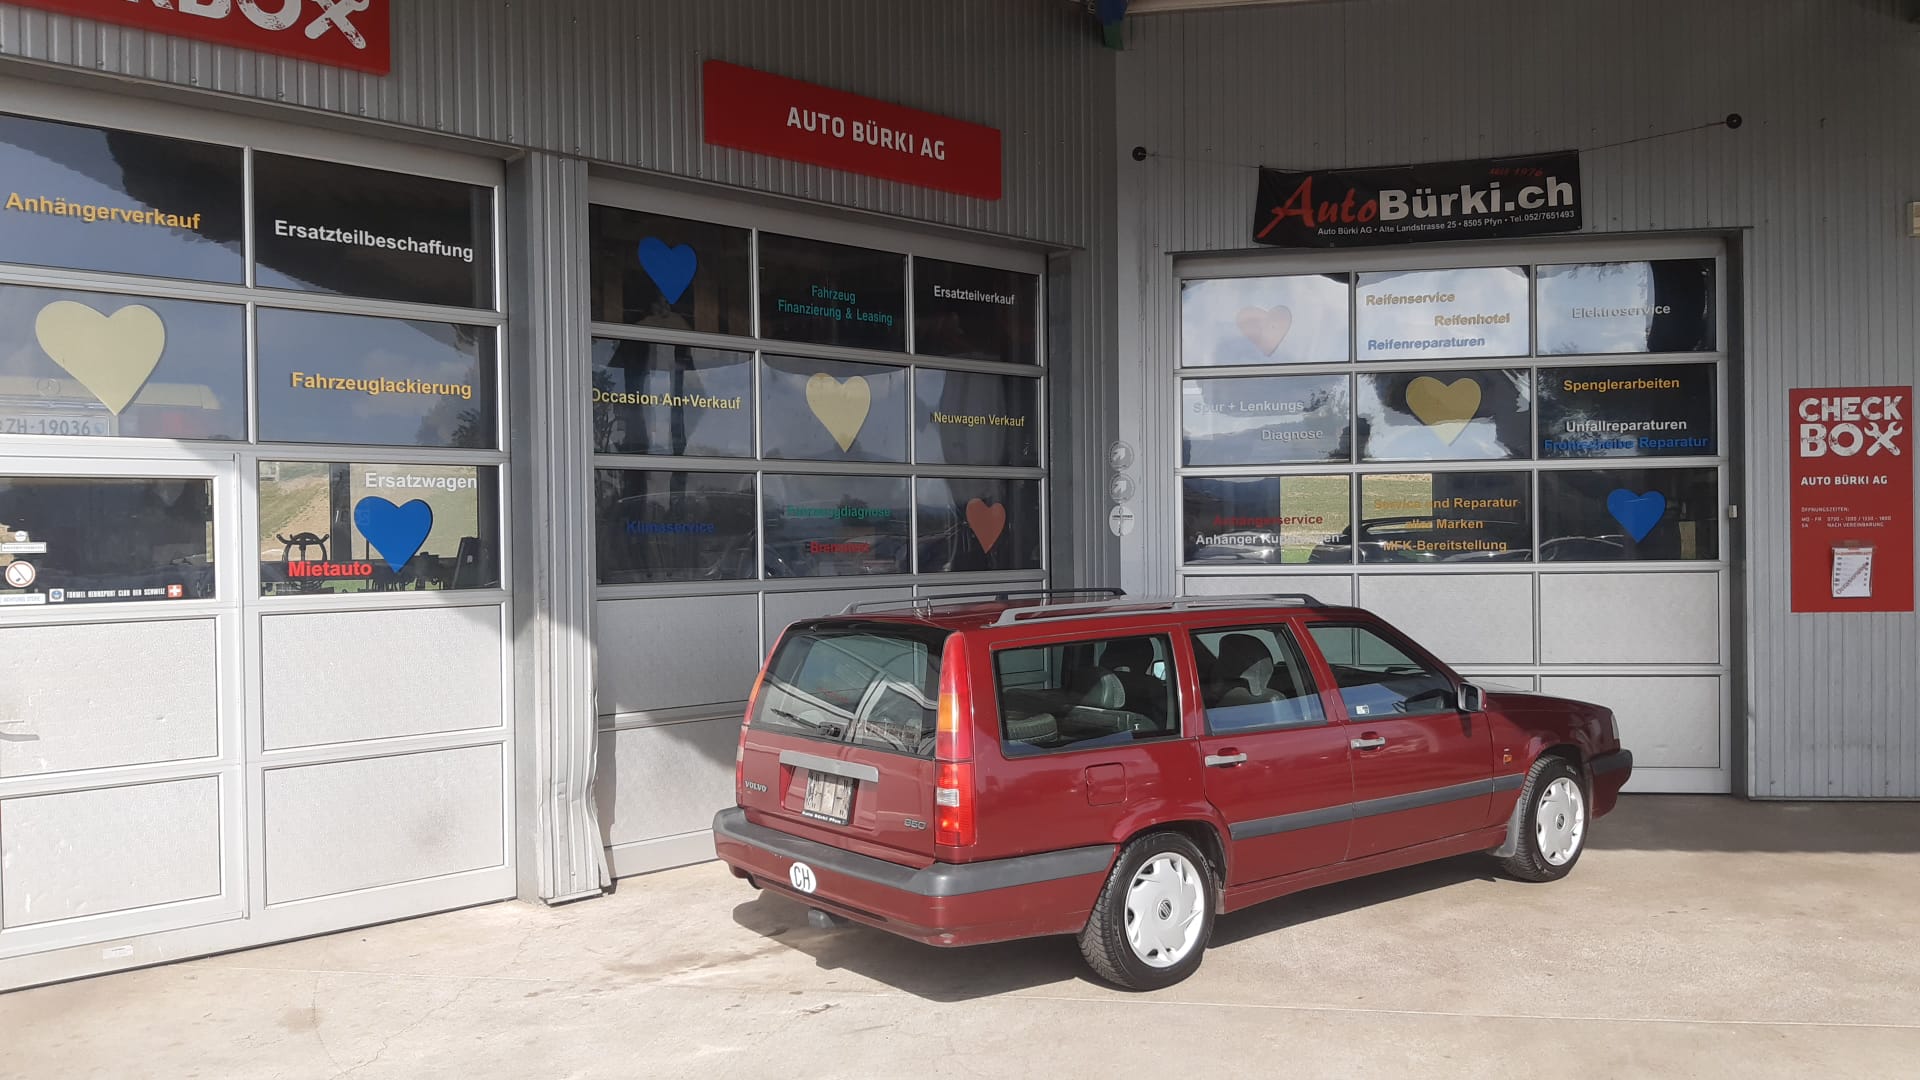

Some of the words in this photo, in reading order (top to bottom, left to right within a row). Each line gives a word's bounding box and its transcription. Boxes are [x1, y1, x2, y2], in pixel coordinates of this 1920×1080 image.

[787, 106, 845, 138] AUTO
[852, 120, 914, 154] BÜRKI
[920, 137, 945, 161] AG
[6, 192, 201, 230] Anhängerverkauf
[1318, 227, 1336, 235] Auto
[1338, 226, 1358, 235] Bürki
[1360, 226, 1372, 234] AG
[1379, 224, 1394, 233] Alte
[1396, 221, 1445, 232] Landstrasse
[1463, 218, 1482, 227] 8505
[1484, 217, 1503, 227] Pfyn
[274, 219, 473, 263] Ersatzteilbeschaffung
[811, 285, 856, 304] Fahrzeug
[934, 285, 1015, 305] Ersatzteilverkauf
[1366, 292, 1456, 306] Reifenservice
[778, 300, 841, 320] Finanzierung
[845, 308, 853, 320] &
[857, 309, 893, 326] Leasing
[1434, 313, 1511, 326] Reifenhotel
[1571, 305, 1671, 319] Elektroservice
[1368, 337, 1486, 351] Reifenreparaturen
[291, 371, 472, 400] Fahrzeuglackierung
[1563, 377, 1680, 393] Spenglerarbeiten
[592, 387, 658, 406] Occasion
[662, 392, 742, 410] An+Verkauf
[1240, 400, 1305, 412] Lenkungs
[1798, 395, 1903, 422] CHECK
[933, 411, 986, 427] Neuwagen
[988, 414, 1025, 427] Verkauf
[1566, 420, 1687, 433] Unfallreparaturen
[1261, 429, 1323, 441] Diagnose
[1639, 436, 1709, 449] Reparatur
[1800, 421, 1903, 457] BOX
[365, 472, 477, 492] Ersatzwagen
[1801, 476, 1831, 486] AUTO
[1834, 474, 1869, 485] BÜRKI
[1872, 475, 1888, 485] AG
[785, 505, 892, 520] Fgdiagnose
[1436, 518, 1484, 529] Marken
[1384, 540, 1508, 555] MFK-Bereitstellung
[288, 560, 373, 577] Mietauto
[744, 780, 768, 793] VOLVO
[794, 865, 811, 890] CH
